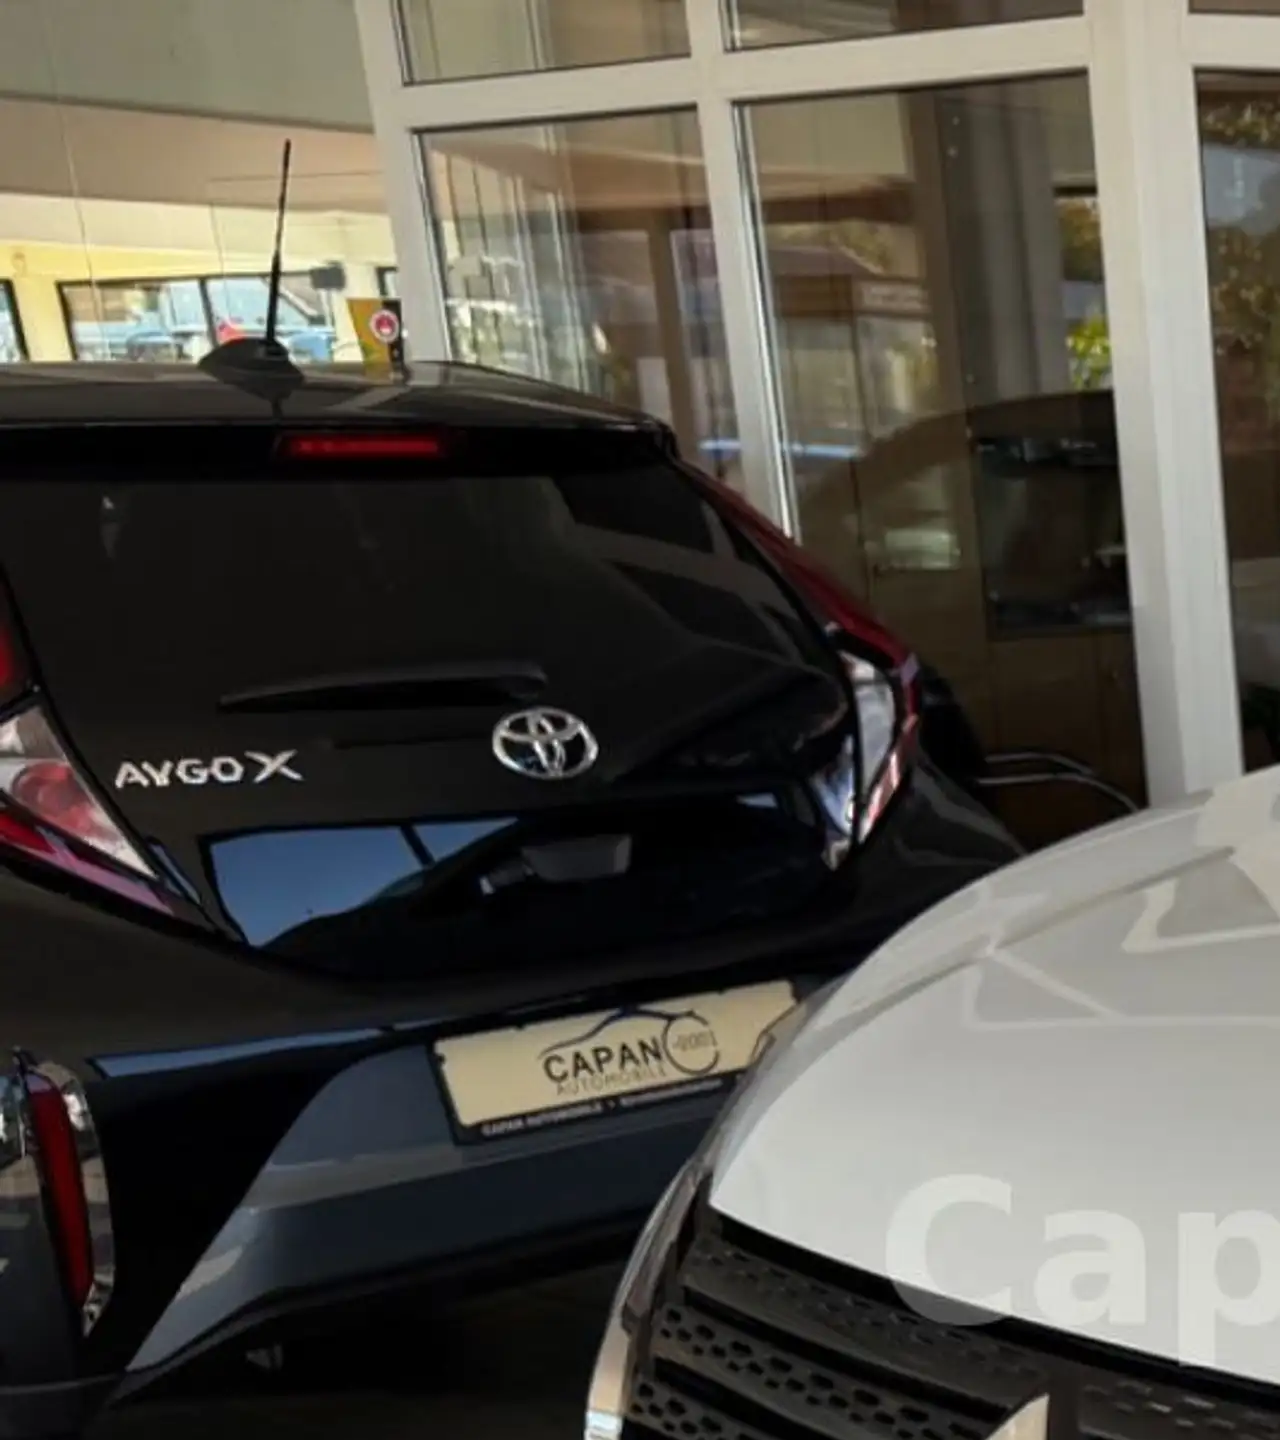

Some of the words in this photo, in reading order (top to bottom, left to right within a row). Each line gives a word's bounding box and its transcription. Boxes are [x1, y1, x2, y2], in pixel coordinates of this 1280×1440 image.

[115, 756, 244, 788] AYGO
[244, 749, 304, 783] X
[543, 1036, 662, 1083] CAPAN
